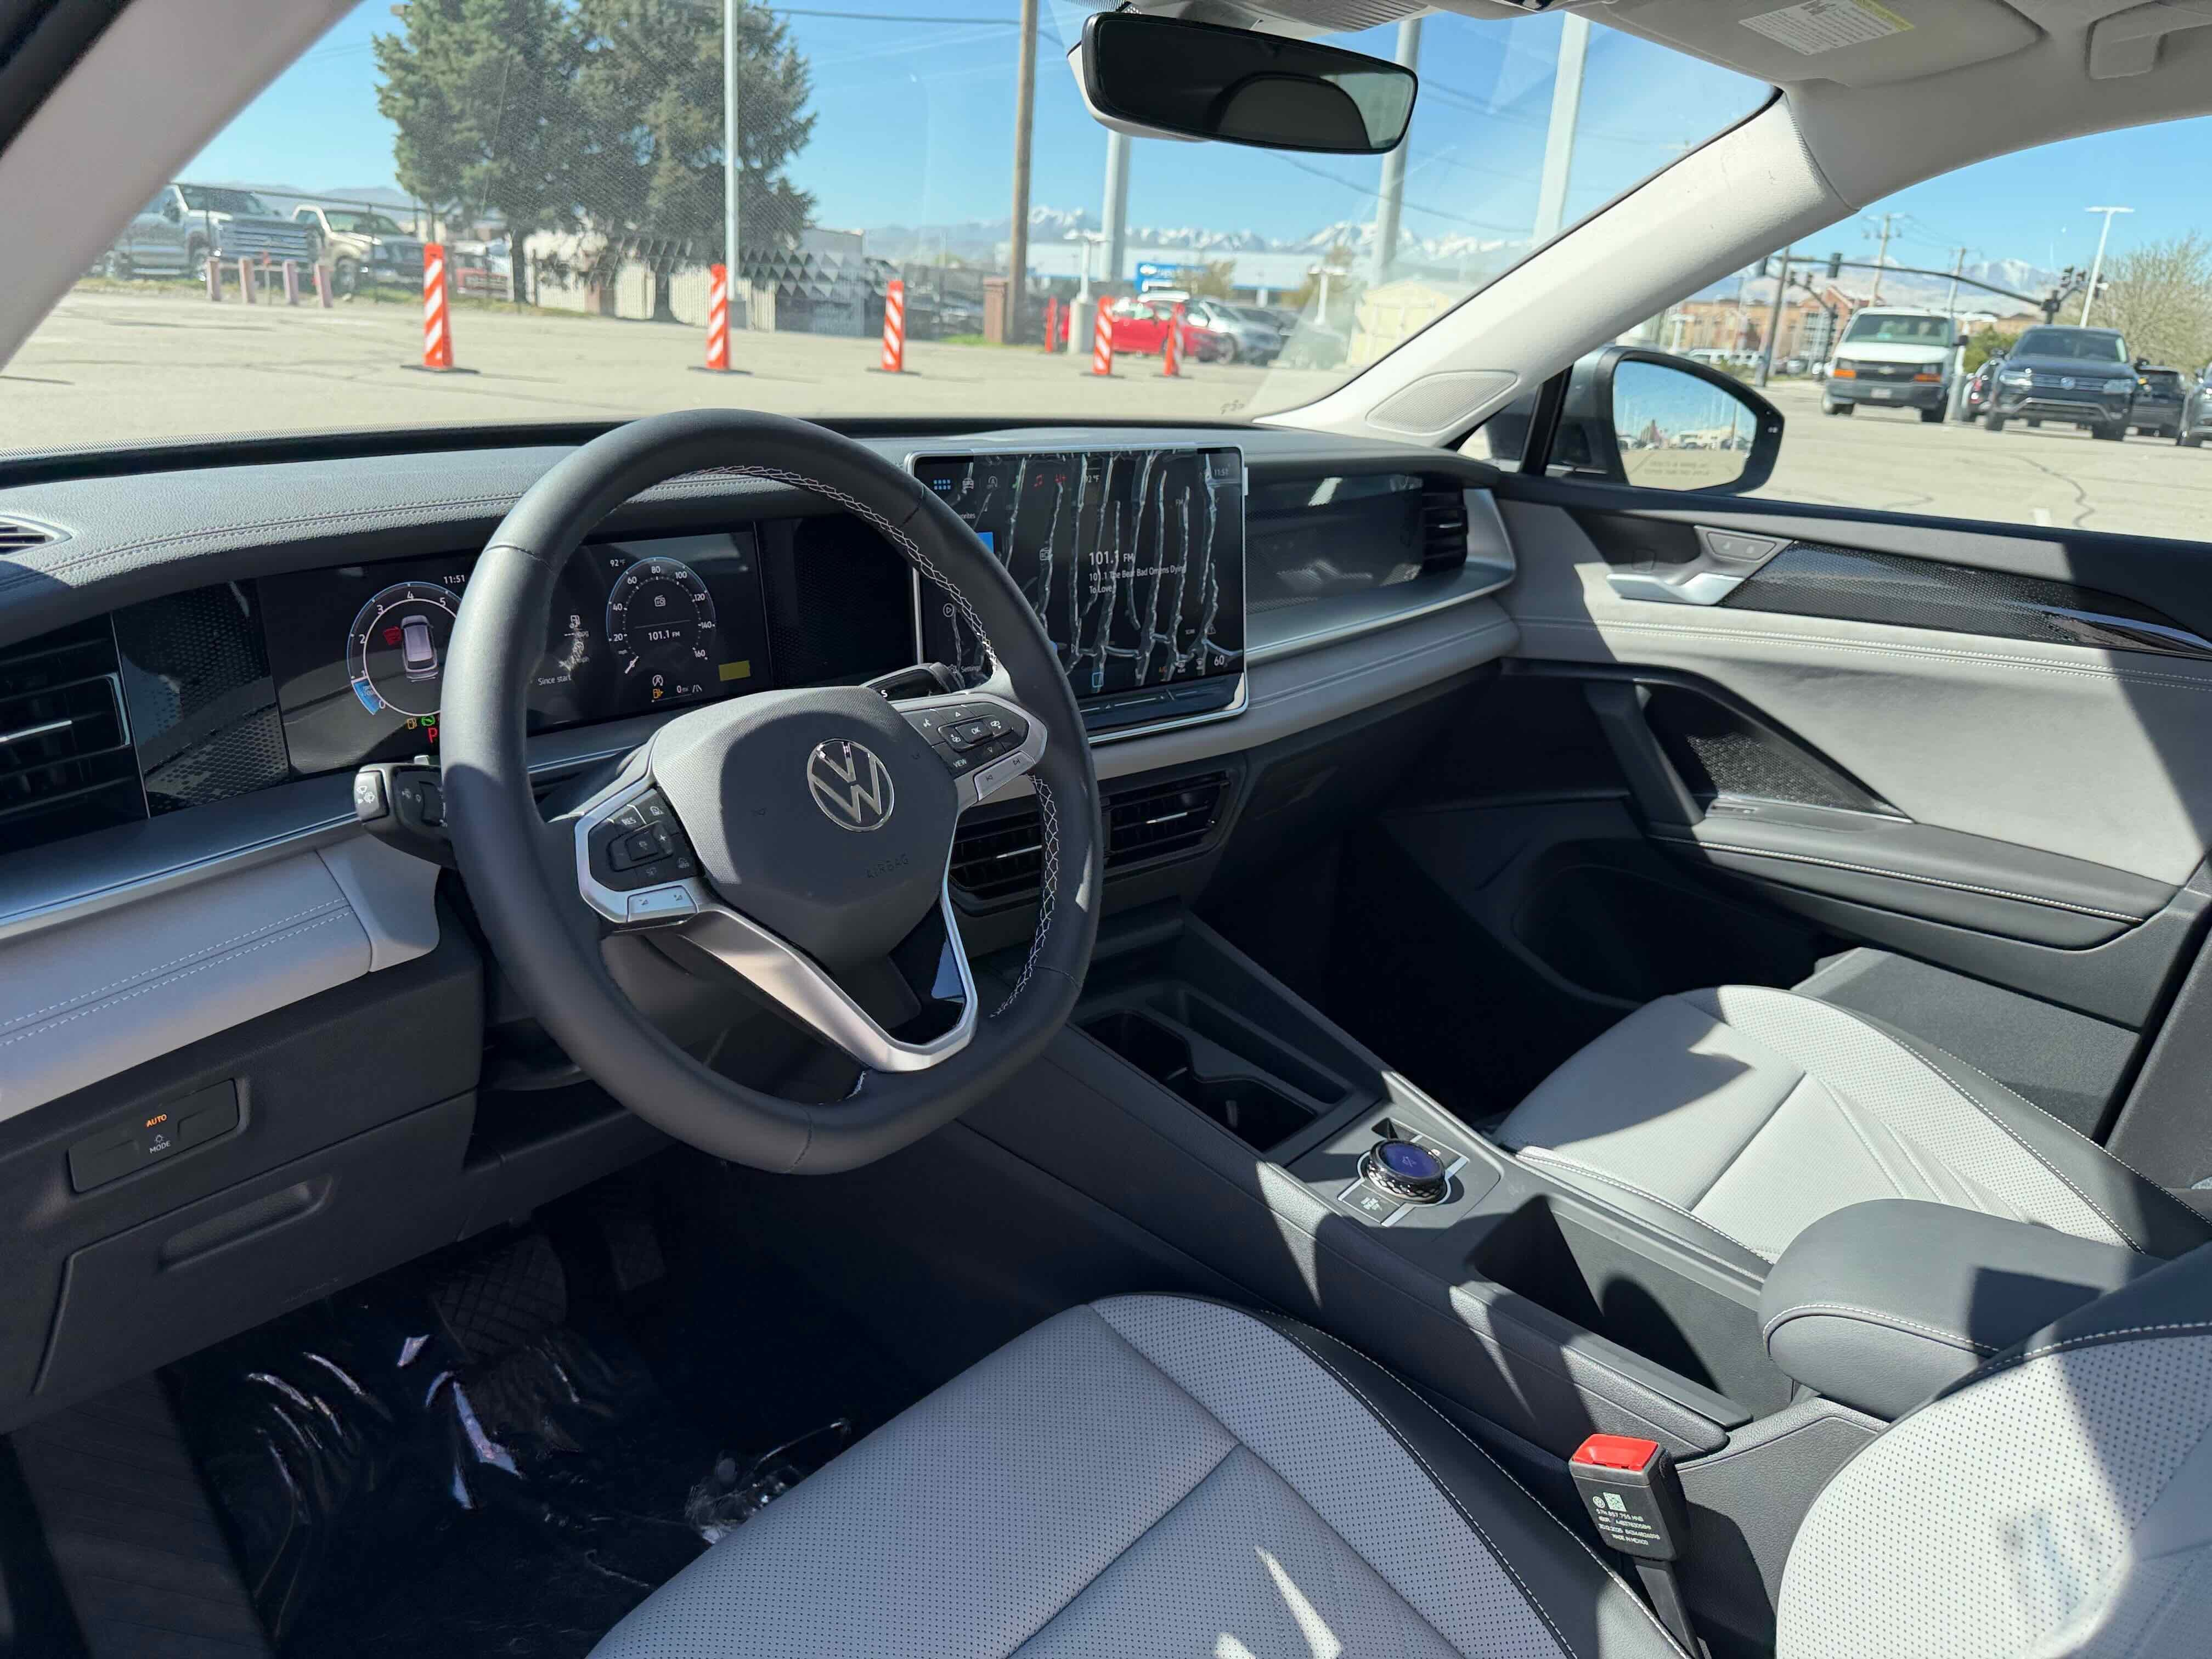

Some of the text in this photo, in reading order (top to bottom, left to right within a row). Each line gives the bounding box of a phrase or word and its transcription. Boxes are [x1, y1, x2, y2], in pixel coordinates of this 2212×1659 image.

[1088, 550, 1135, 566] 101.1 FM
[610, 559, 619, 567] 92
[651, 566, 661, 574] 80
[1136, 567, 1148, 577] Bad
[443, 574, 465, 584] 11:51
[675, 571, 687, 579] 100
[627, 577, 637, 585] 60
[1089, 585, 1097, 594] To
[407, 591, 414, 599] 4
[693, 593, 705, 602] 120
[439, 597, 446, 606] 5
[376, 604, 383, 614] 3
[613, 603, 623, 611] 40
[701, 621, 712, 629] 140
[358, 634, 365, 644] 2
[613, 633, 623, 642] 20
[648, 629, 670, 641] 101.1
[693, 650, 706, 658] 160
[1214, 654, 1224, 666] 60
[538, 674, 572, 686] Since start
[676, 685, 682, 693] 0
[427, 727, 438, 743] P
[971, 726, 980, 735] OK
[953, 758, 967, 768] VIEW
[145, 1114, 167, 1127] AUTO
[149, 1140, 171, 1154] MODE
